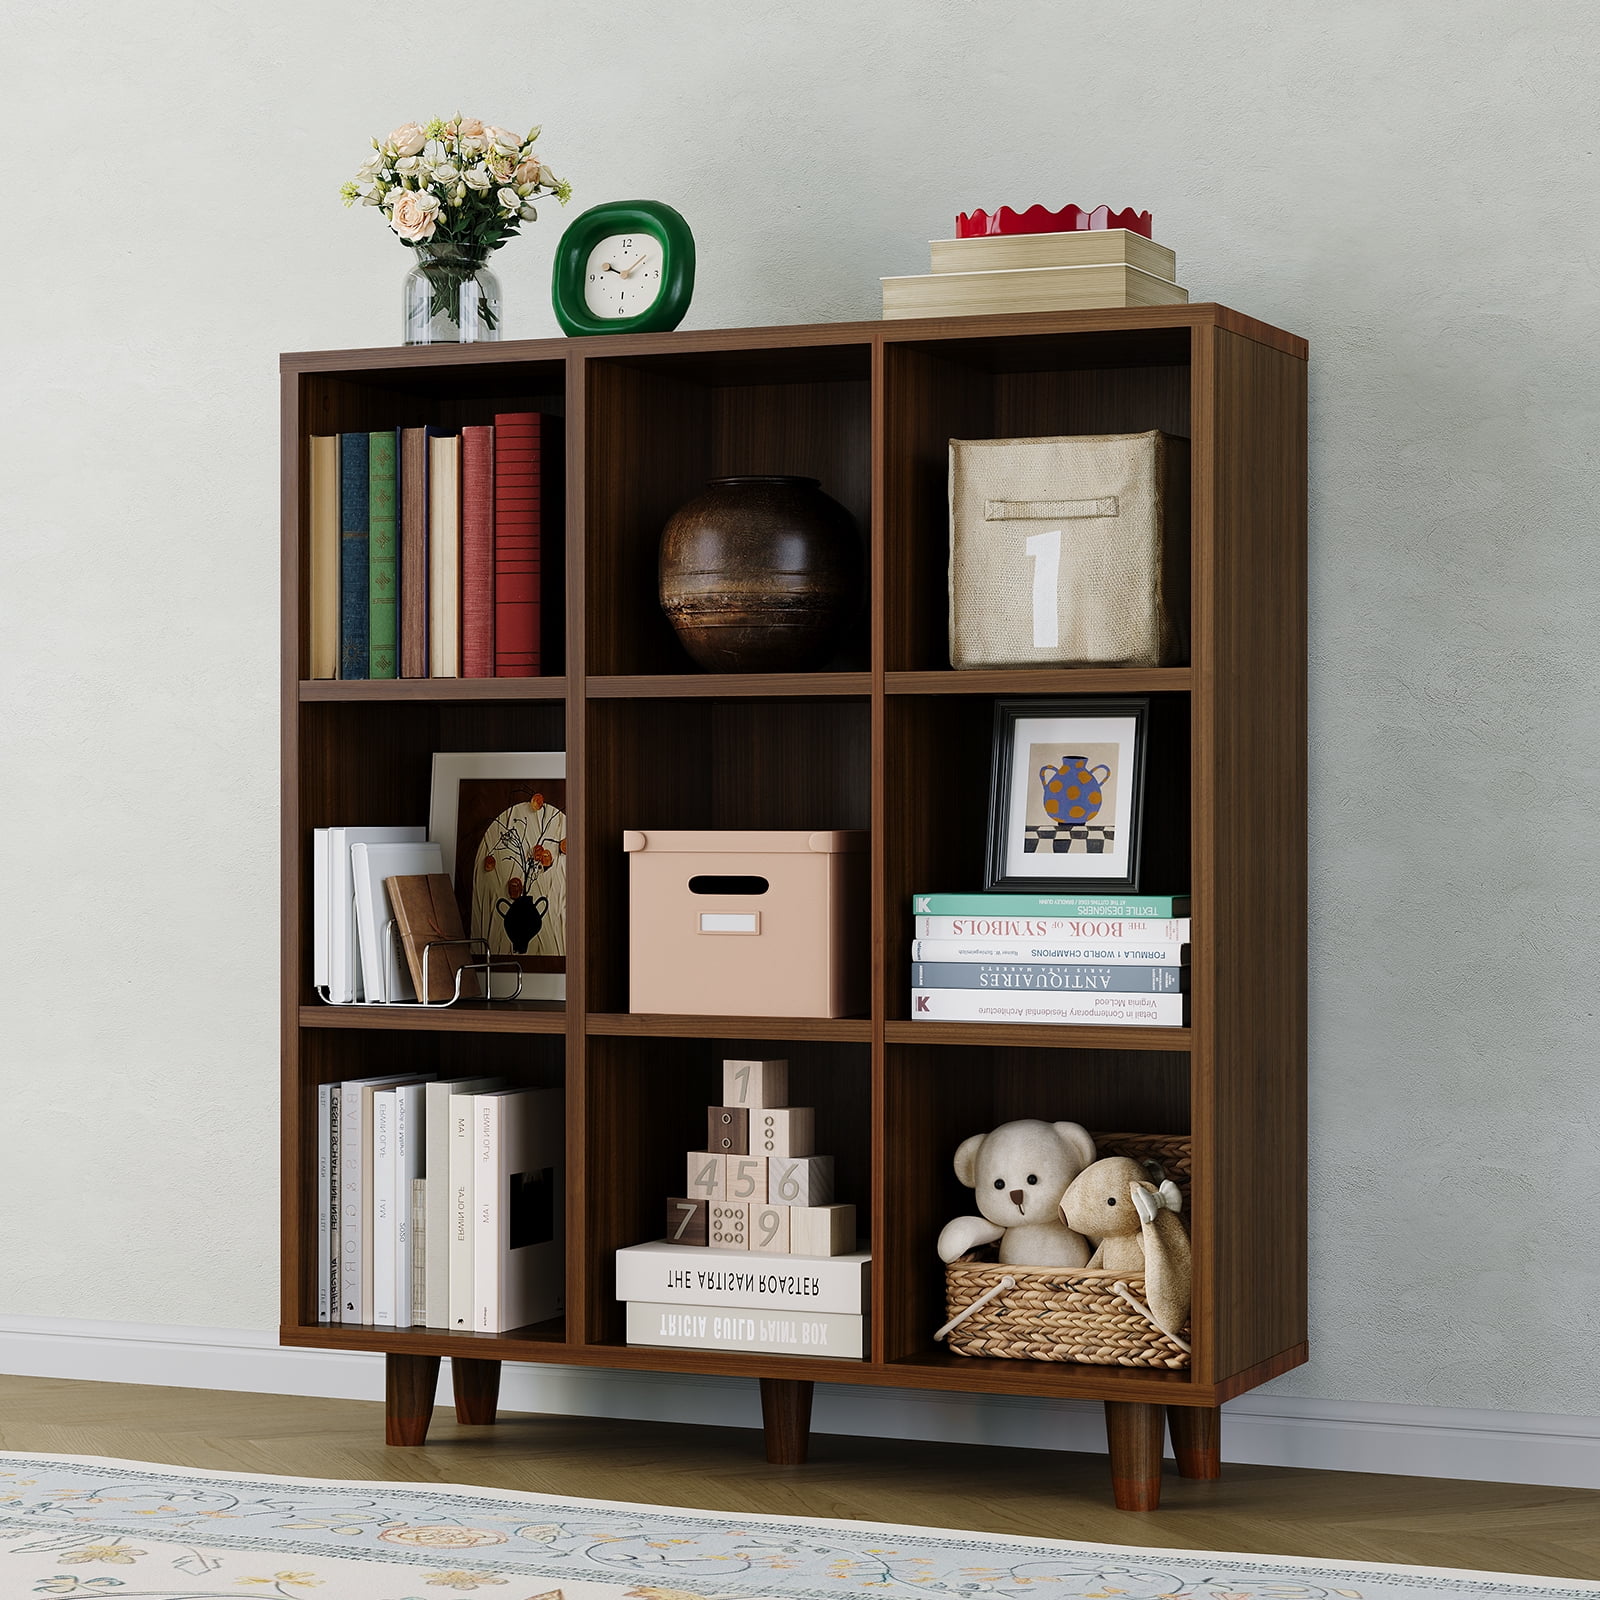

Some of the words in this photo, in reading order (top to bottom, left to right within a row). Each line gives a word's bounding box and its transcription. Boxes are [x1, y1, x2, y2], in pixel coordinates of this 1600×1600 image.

[622, 239, 632, 247] 12
[590, 274, 595, 282] 9
[653, 270, 659, 278] 3
[618, 306, 624, 314] 6
[1026, 530, 1061, 648] 1
[1077, 906, 1123, 915] DESIGNERS
[1126, 907, 1158, 915] TEXTILE
[953, 920, 1047, 936] SYMBOLS
[1069, 921, 1122, 937] BOOK
[1031, 949, 1082, 958] CHAMPIONS
[1084, 950, 1114, 958] WORLD
[1124, 951, 1166, 960] FORMULA
[980, 971, 1111, 989] ANTIQUAIRES
[1095, 999, 1125, 1007] McLeod
[1128, 999, 1157, 1007] Virginia
[979, 1007, 1023, 1016] Architecture
[1026, 1008, 1067, 1017] Residential
[1069, 1008, 1124, 1018] Contemporary
[1135, 1011, 1158, 1019] Detail
[735, 1066, 750, 1103] 1
[694, 1159, 718, 1195] 4
[735, 1161, 758, 1198] 5
[778, 1163, 800, 1201] 6
[673, 1203, 698, 1240] 7
[759, 1210, 779, 1247] 9
